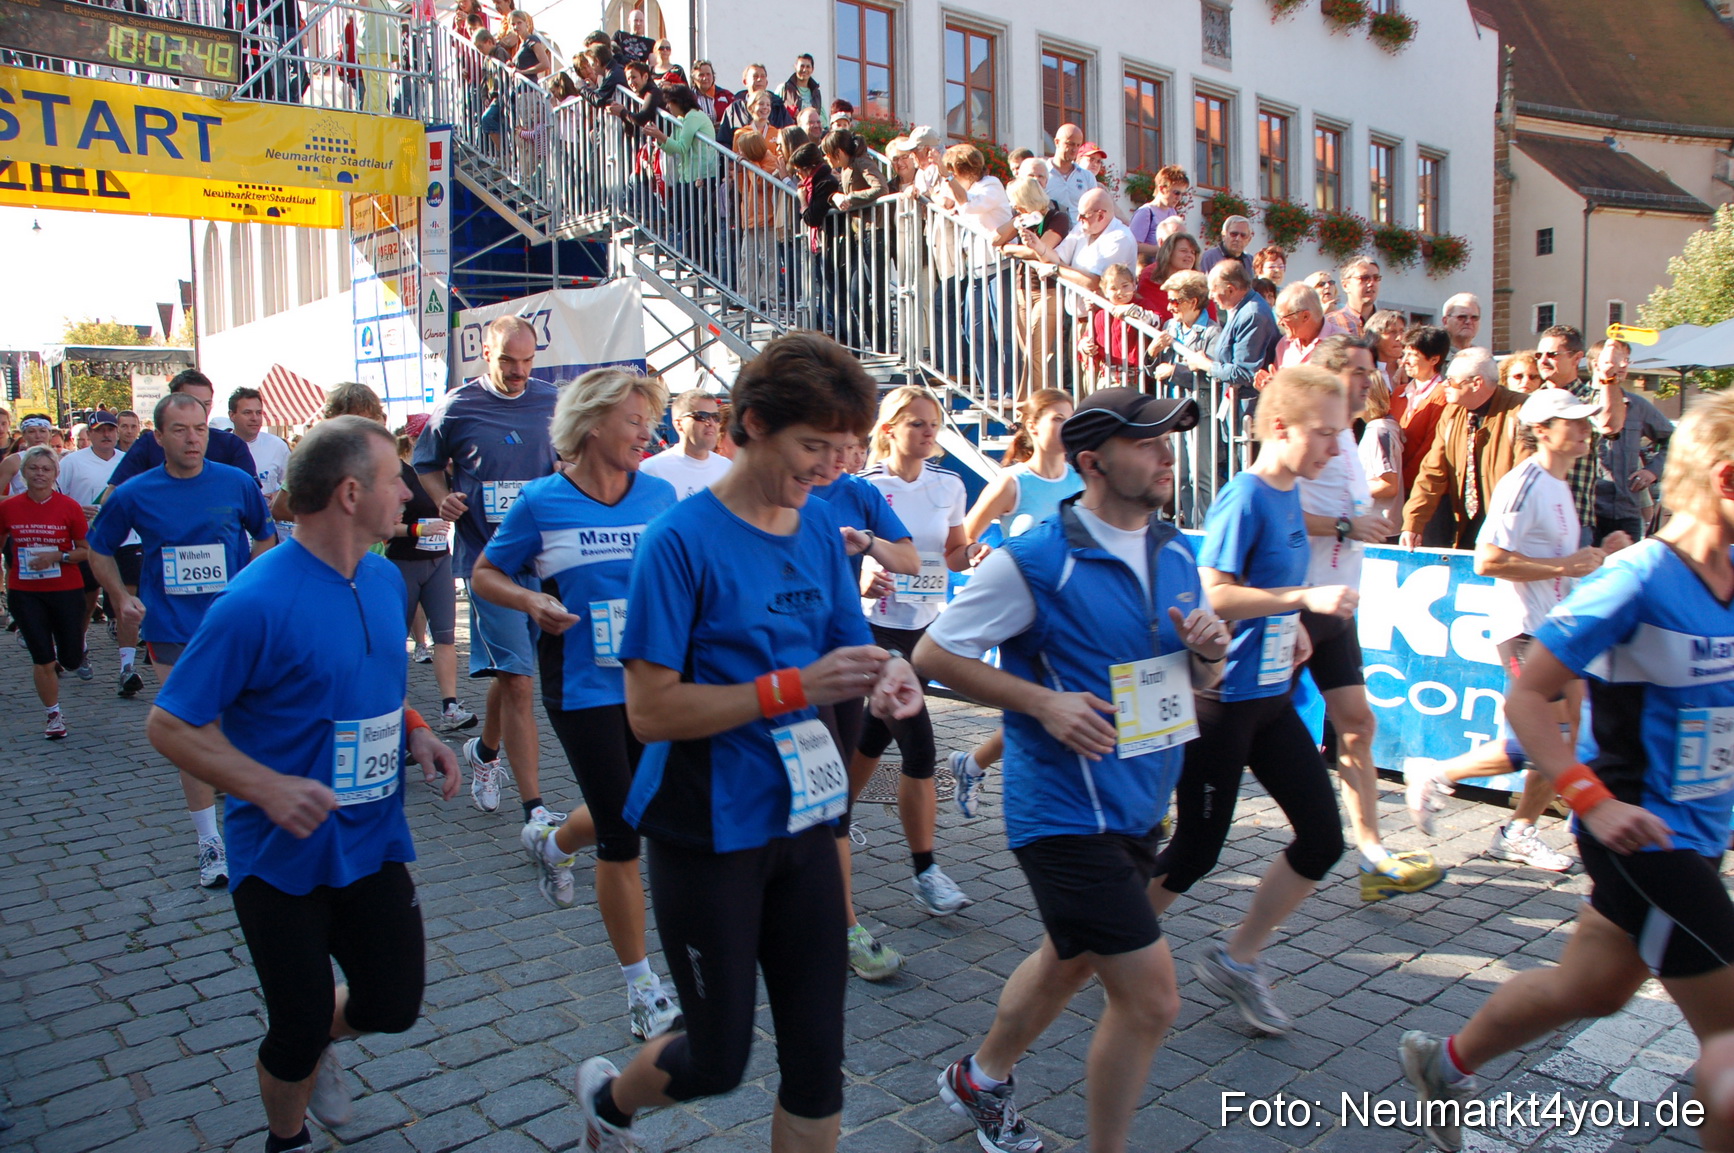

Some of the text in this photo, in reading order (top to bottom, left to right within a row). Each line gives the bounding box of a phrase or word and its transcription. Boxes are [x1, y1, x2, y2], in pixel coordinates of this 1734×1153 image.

[63, 4, 125, 24] Elektronische
[0, 87, 223, 163] START
[265, 148, 394, 170] Neumarkter Stadtlauf
[202, 187, 317, 206] Neumarkter Stadtlauf
[497, 480, 522, 489] Martin
[179, 550, 211, 561] Wilhelm
[182, 565, 222, 581] 2696
[912, 574, 944, 590] 2826
